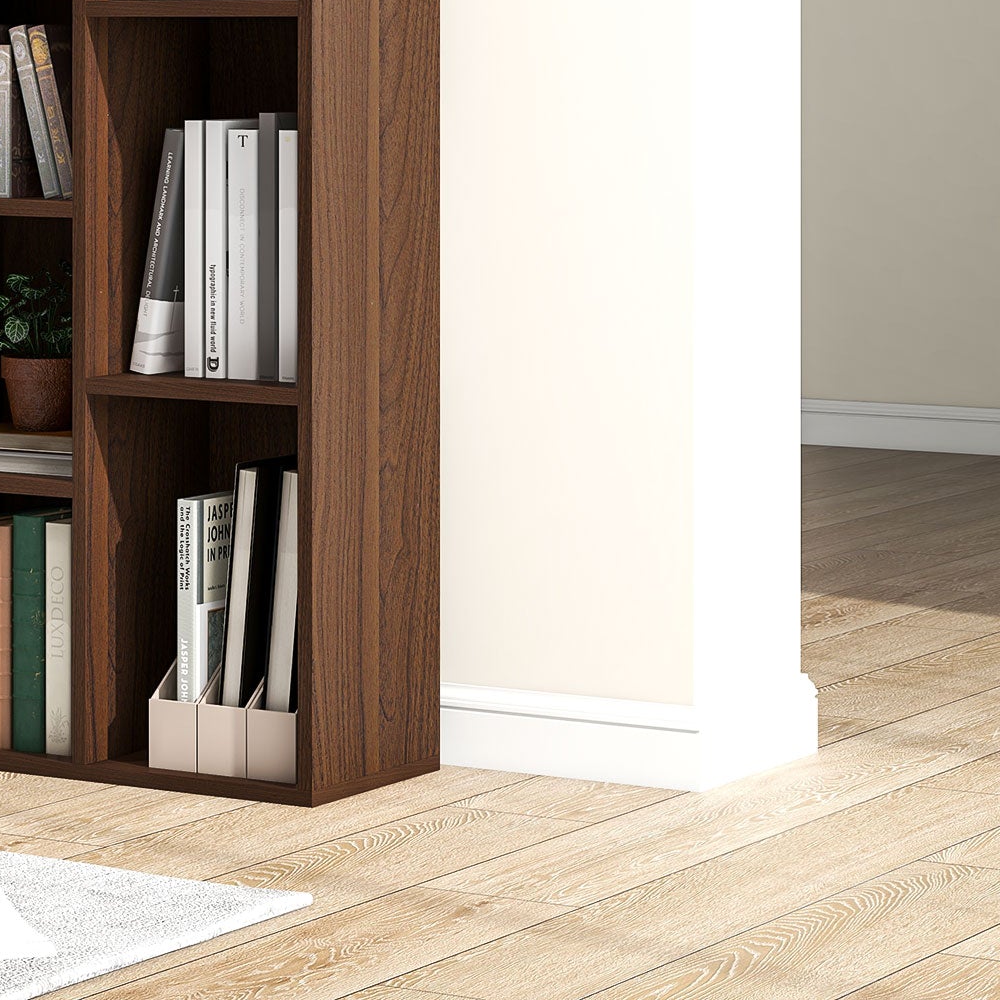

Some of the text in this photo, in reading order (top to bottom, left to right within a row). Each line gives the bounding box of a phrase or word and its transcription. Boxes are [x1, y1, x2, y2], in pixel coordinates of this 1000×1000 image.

[238, 135, 248, 147] T
[164, 152, 173, 184] LEARNING
[158, 186, 168, 220] LANDMARK
[145, 239, 159, 288] ARCHITECTURAL
[207, 502, 233, 522] JASPE
[207, 524, 231, 543] JOHN
[207, 545, 231, 562] IN PRI
[180, 562, 184, 570] of
[51, 566, 64, 658] LUXDECO
